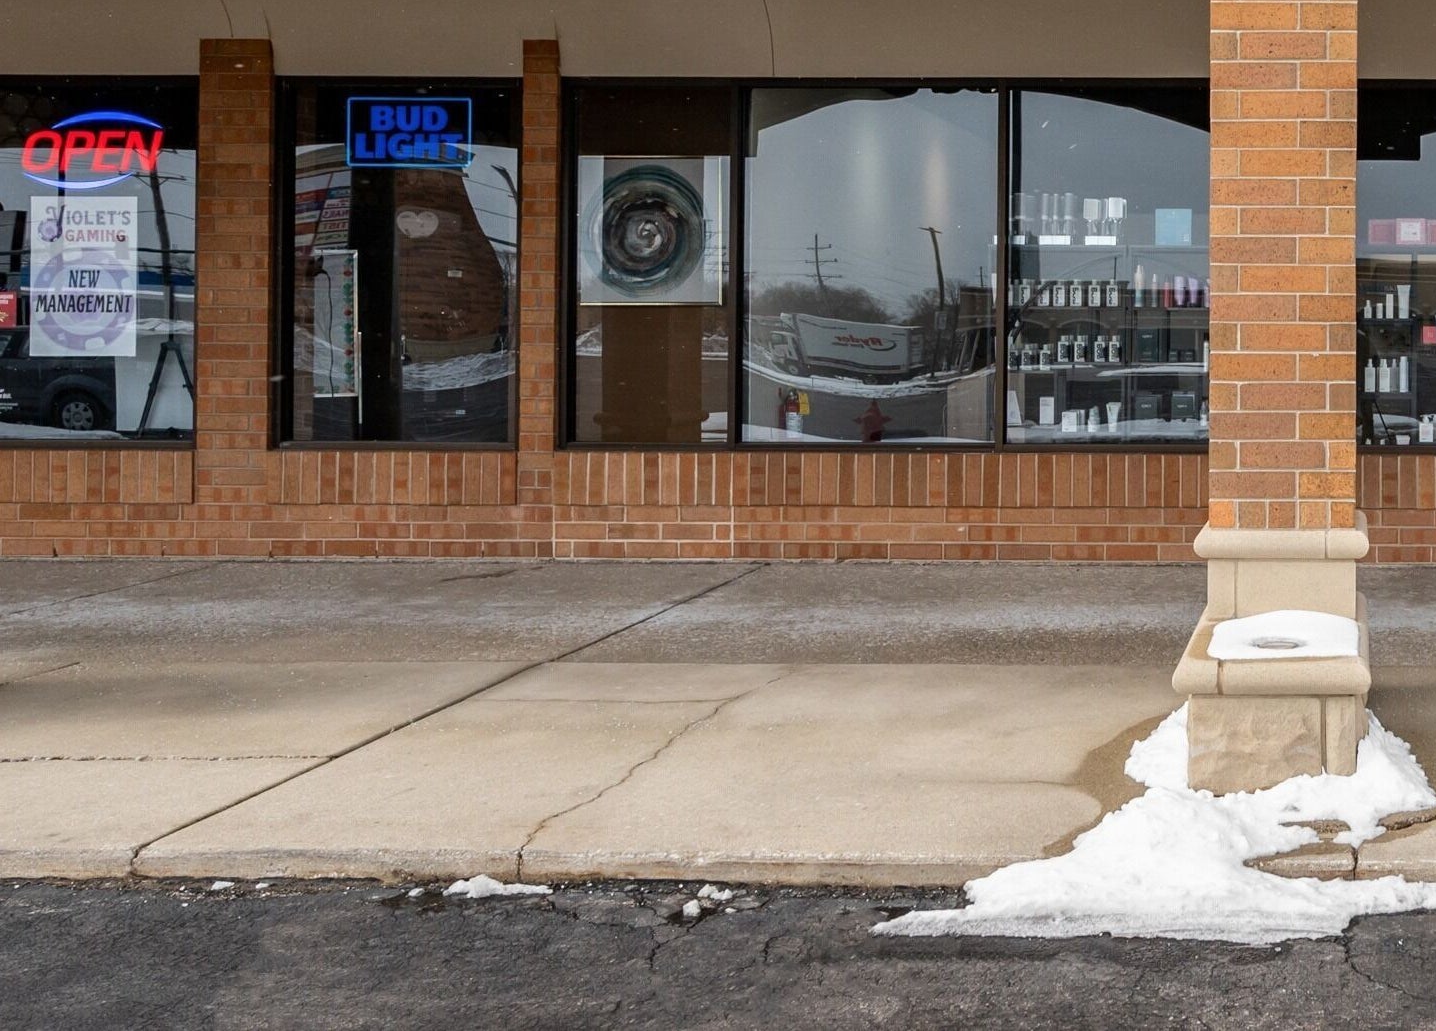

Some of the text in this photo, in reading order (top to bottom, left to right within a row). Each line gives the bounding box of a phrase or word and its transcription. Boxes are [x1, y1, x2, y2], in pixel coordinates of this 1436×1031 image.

[370, 105, 448, 131] BUD
[21, 129, 165, 174] OPEN
[355, 132, 463, 160] LIGHT
[44, 204, 131, 228] VIOLET'S
[64, 228, 127, 243] GAMING
[68, 269, 100, 288] NEW
[35, 294, 132, 313] MANAGEMENT
